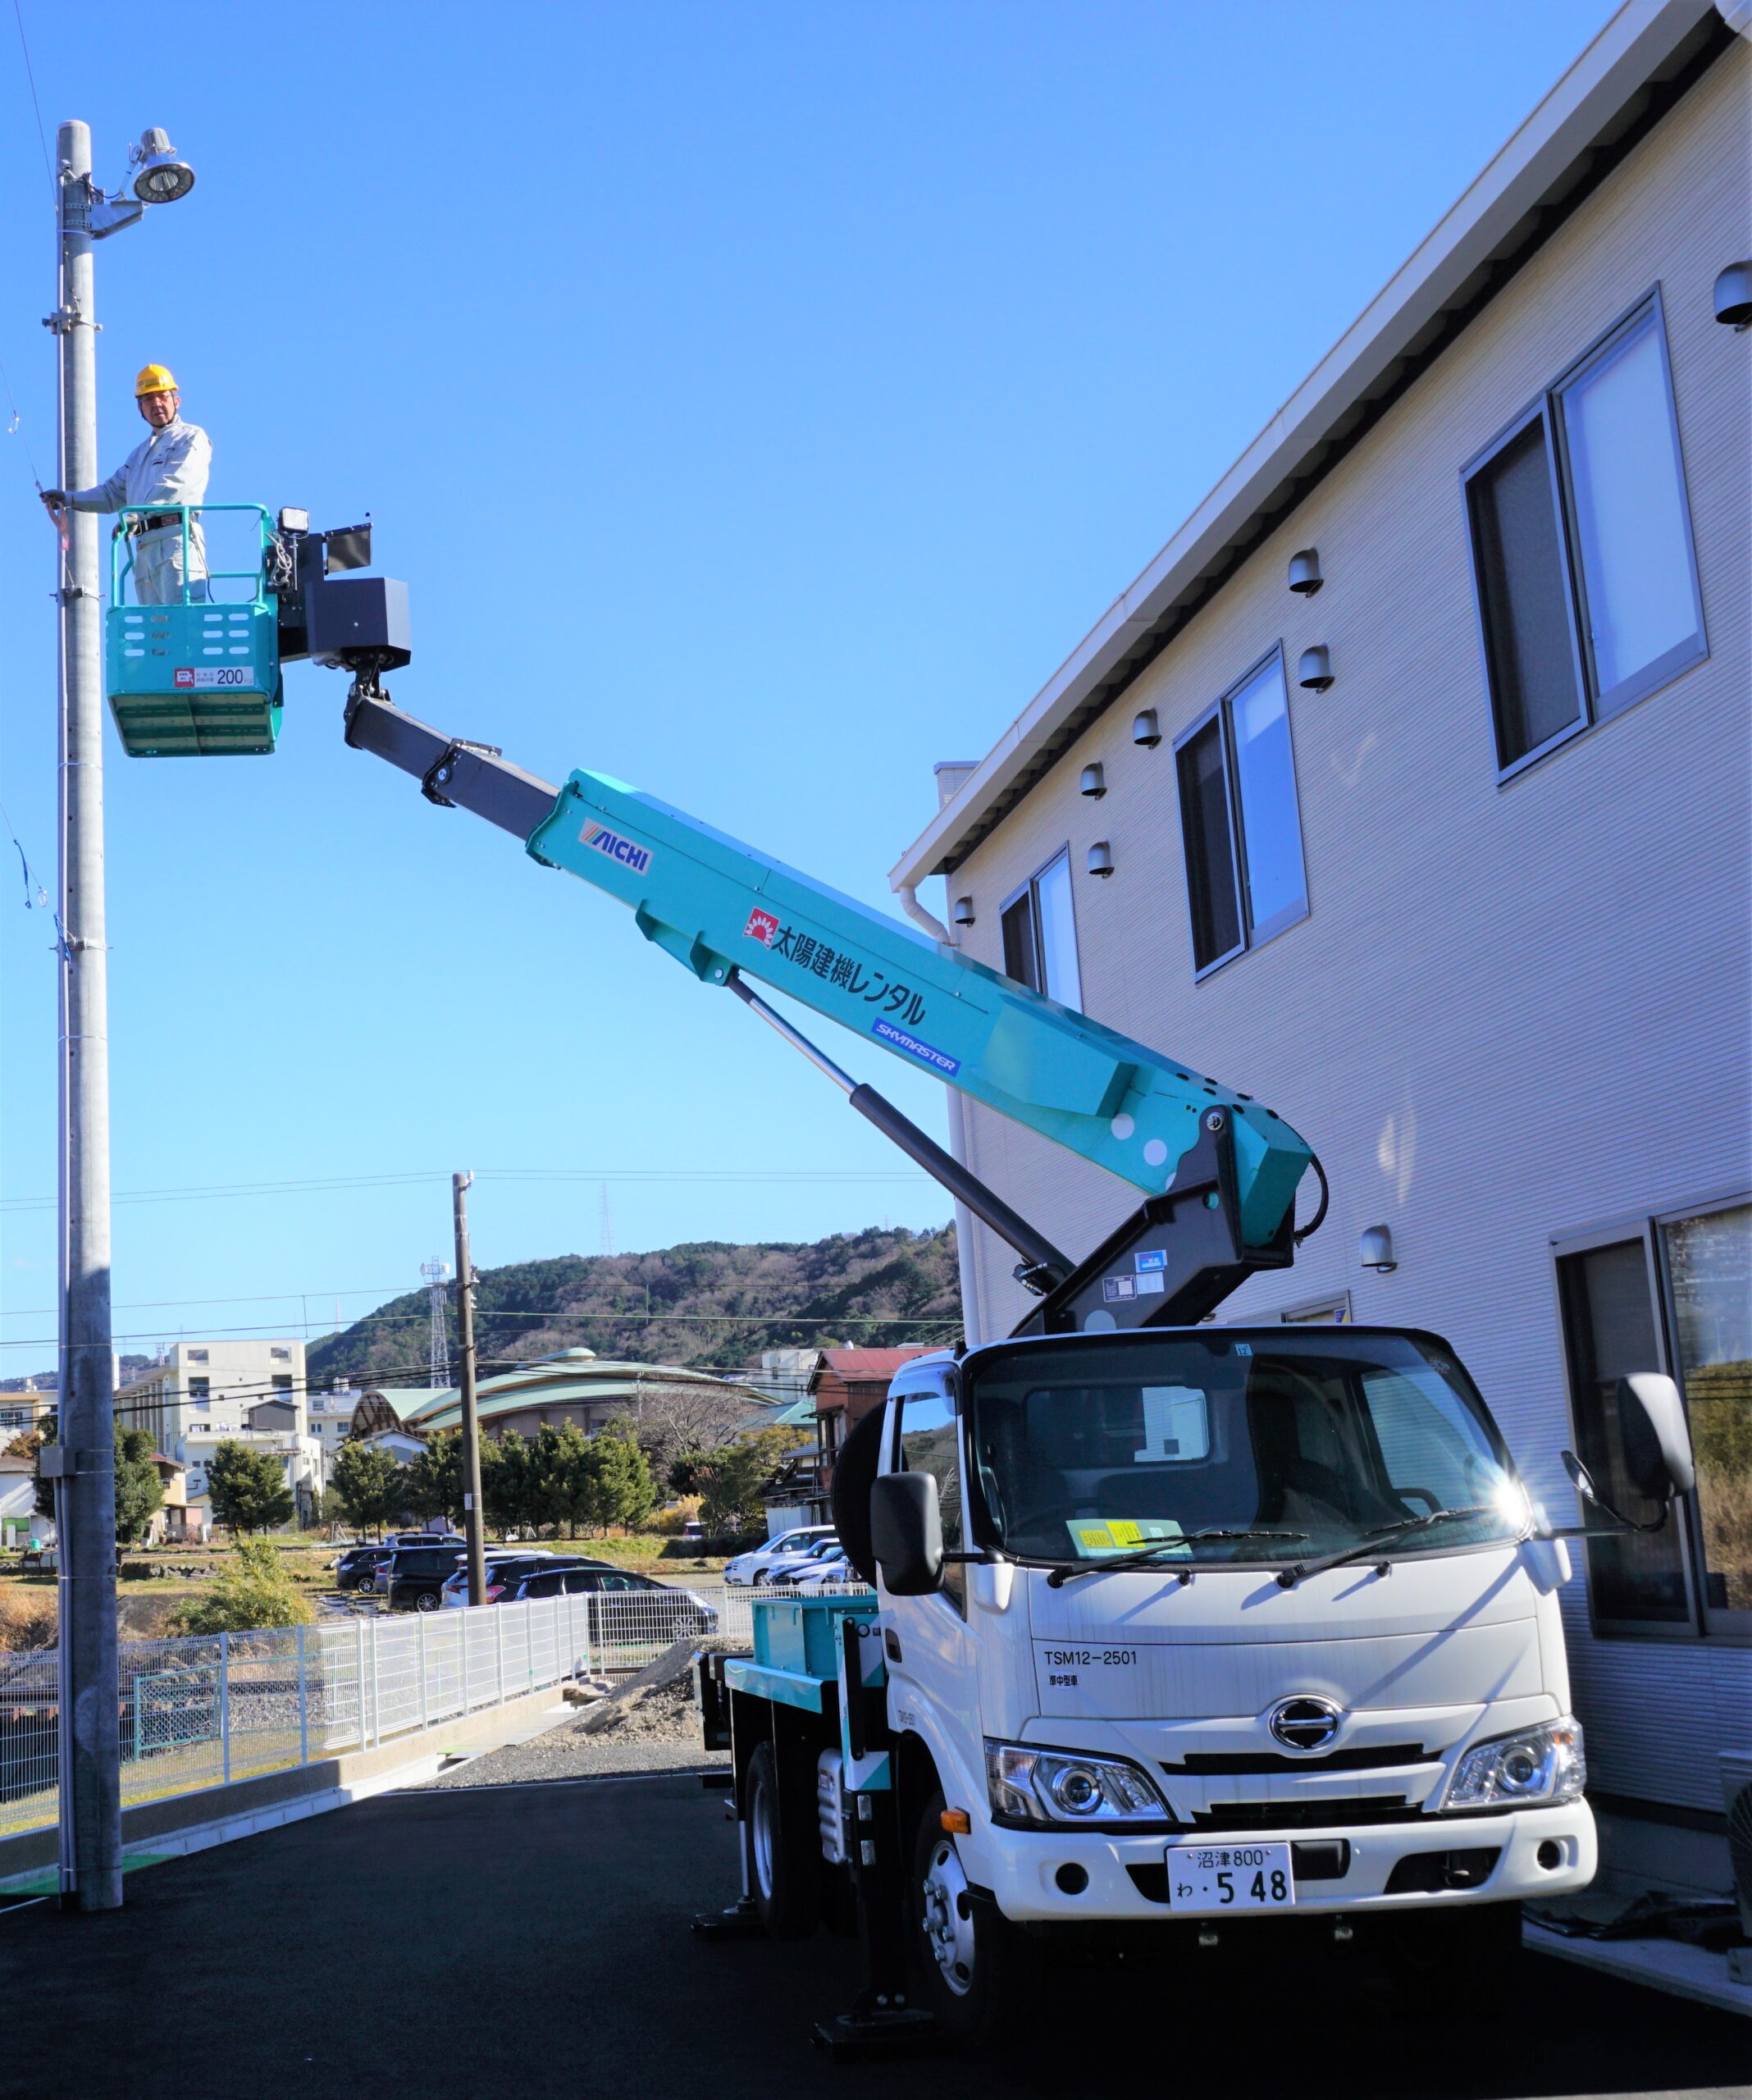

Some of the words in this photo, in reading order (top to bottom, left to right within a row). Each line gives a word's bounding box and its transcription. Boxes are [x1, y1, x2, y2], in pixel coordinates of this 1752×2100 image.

[217, 669, 244, 685] 200
[591, 830, 649, 871] AICHI
[772, 925, 926, 1026] 太陽建機レンタル
[876, 1023, 956, 1071] SKYMASTER
[1044, 1650, 1137, 1665] TSM12-2501
[1049, 1675, 1079, 1687] 準中型車
